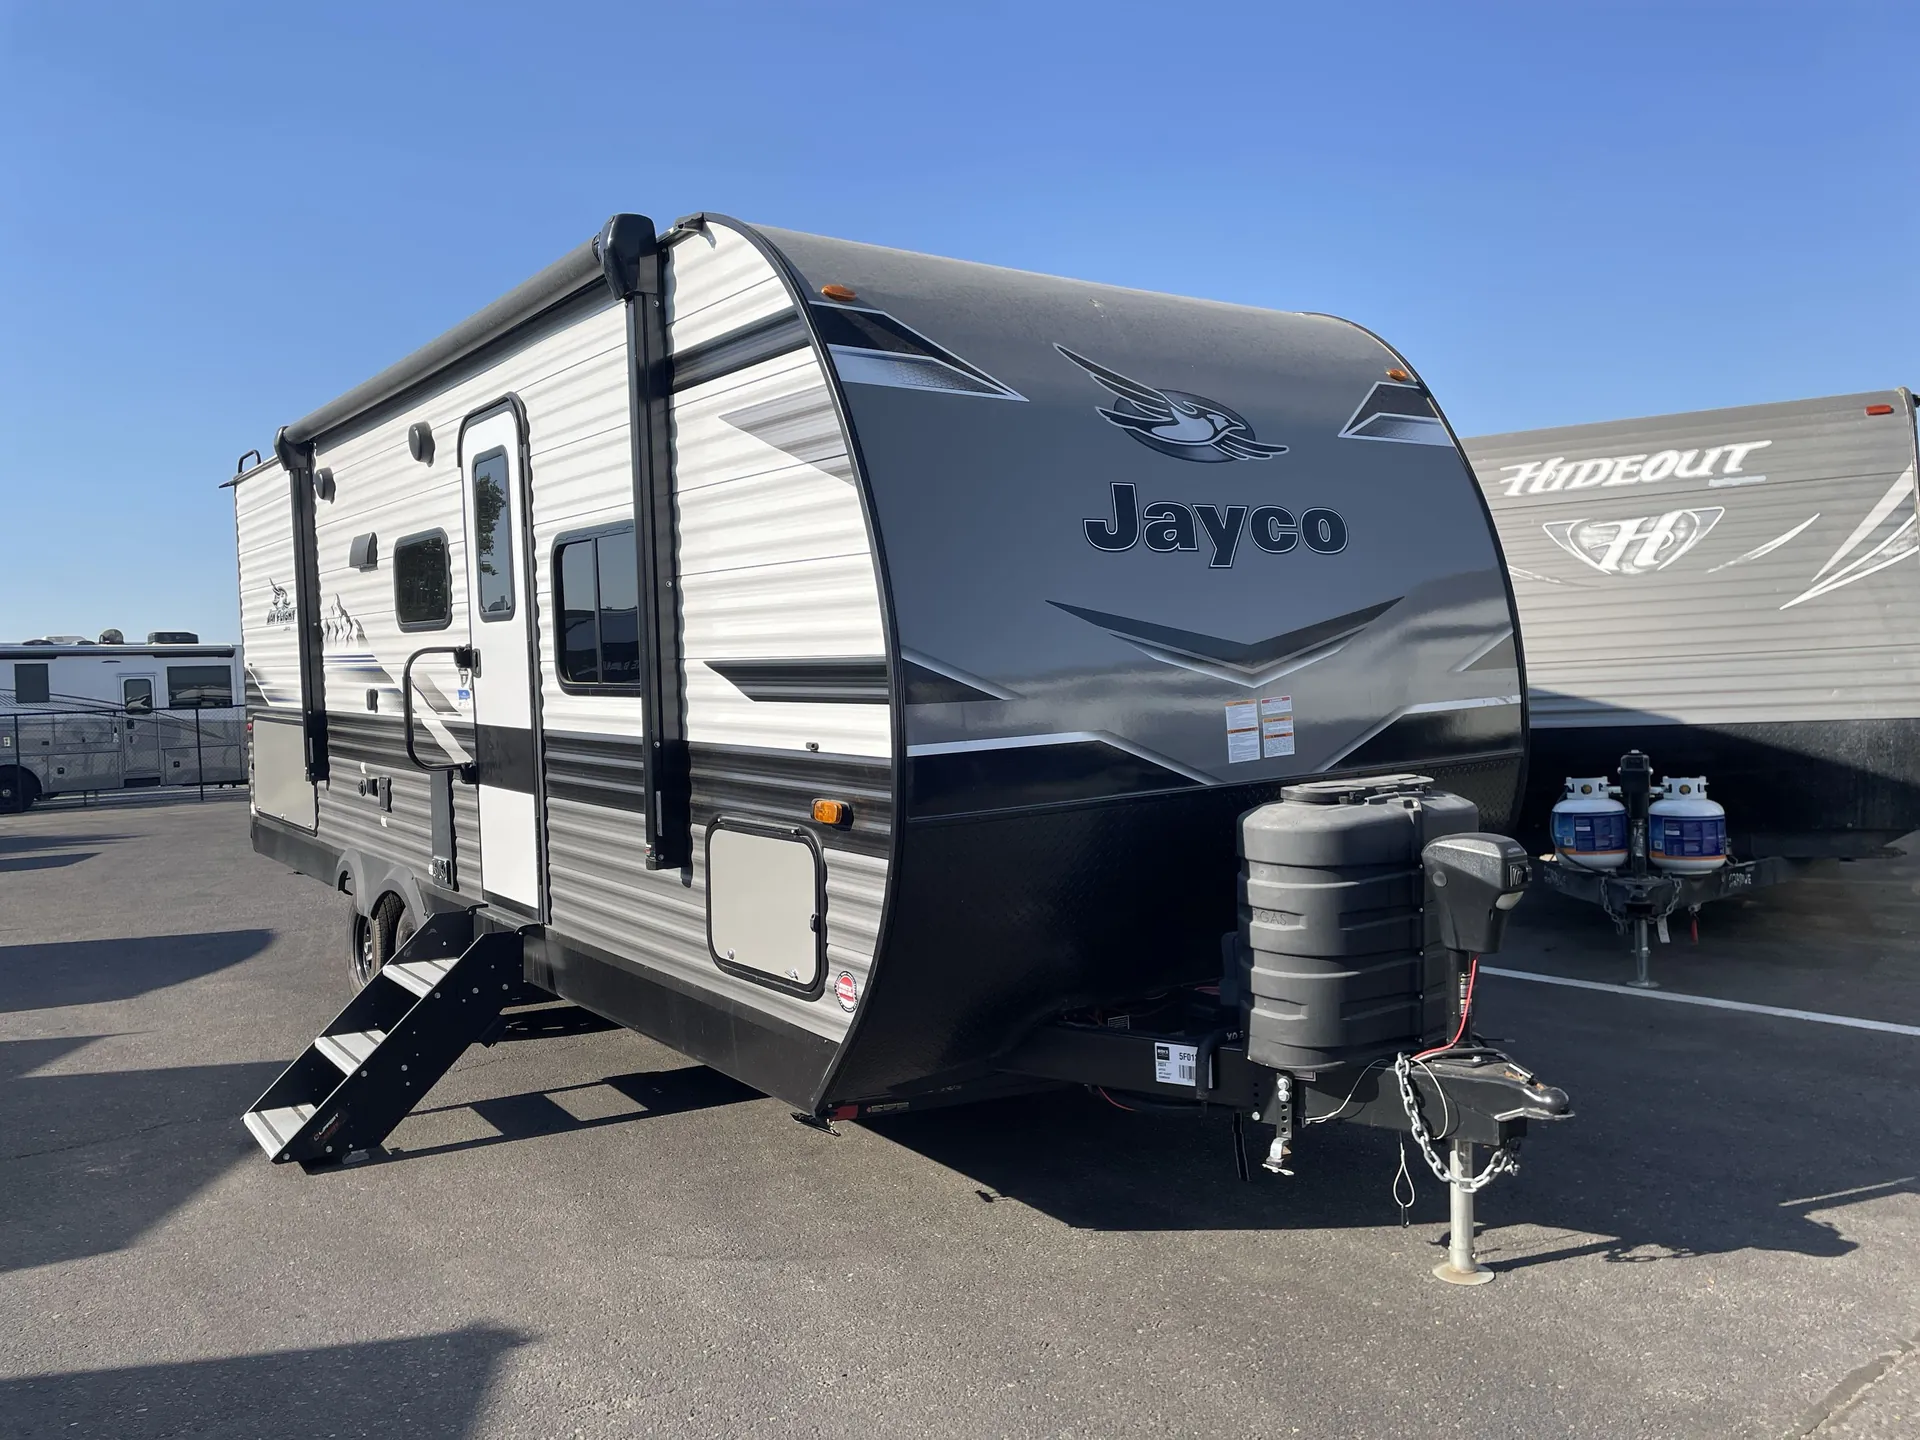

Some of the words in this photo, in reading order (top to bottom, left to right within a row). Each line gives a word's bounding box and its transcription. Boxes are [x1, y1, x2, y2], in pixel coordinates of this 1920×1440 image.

[1499, 439, 1773, 497] HIDEOUT
[1082, 480, 1350, 569] Jayco
[1260, 910, 1287, 926] GAS
